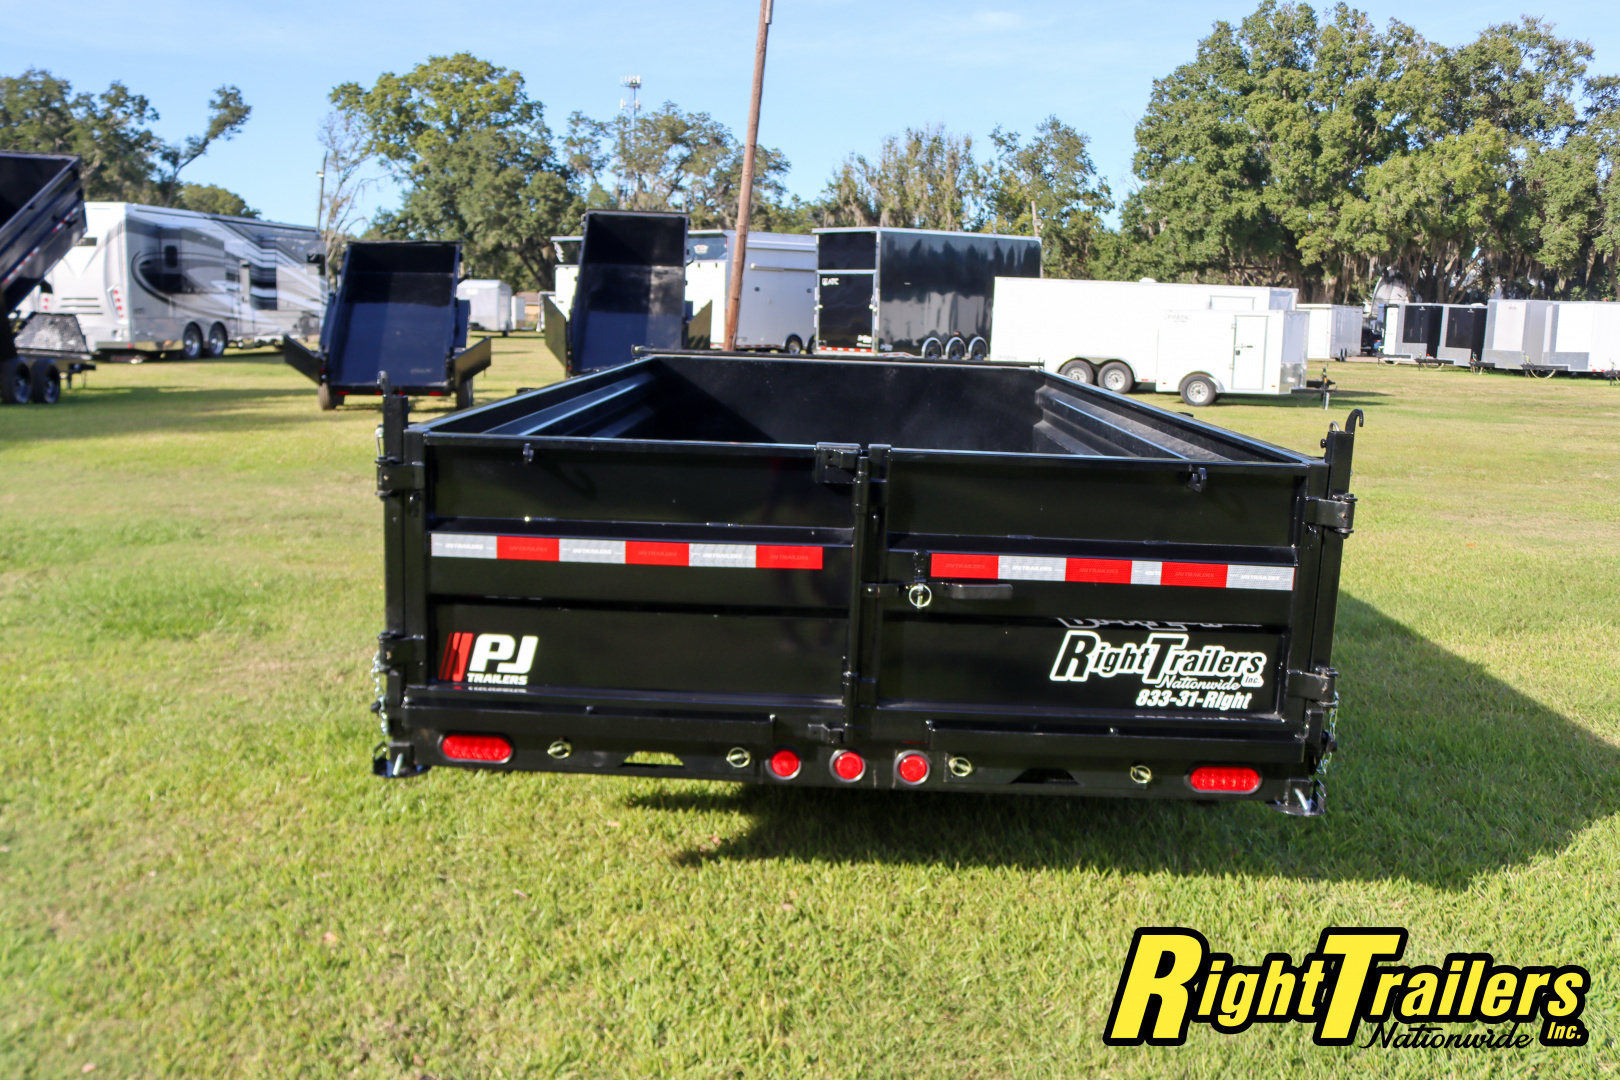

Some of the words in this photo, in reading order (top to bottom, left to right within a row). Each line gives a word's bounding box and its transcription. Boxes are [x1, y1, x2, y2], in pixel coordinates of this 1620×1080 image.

[469, 633, 539, 674] PJ
[467, 672, 528, 685] TRAILERS
[1154, 674, 1241, 690] Nationwide
[1243, 674, 1262, 686] Inc.
[1135, 689, 1252, 710] 833-31-Right
